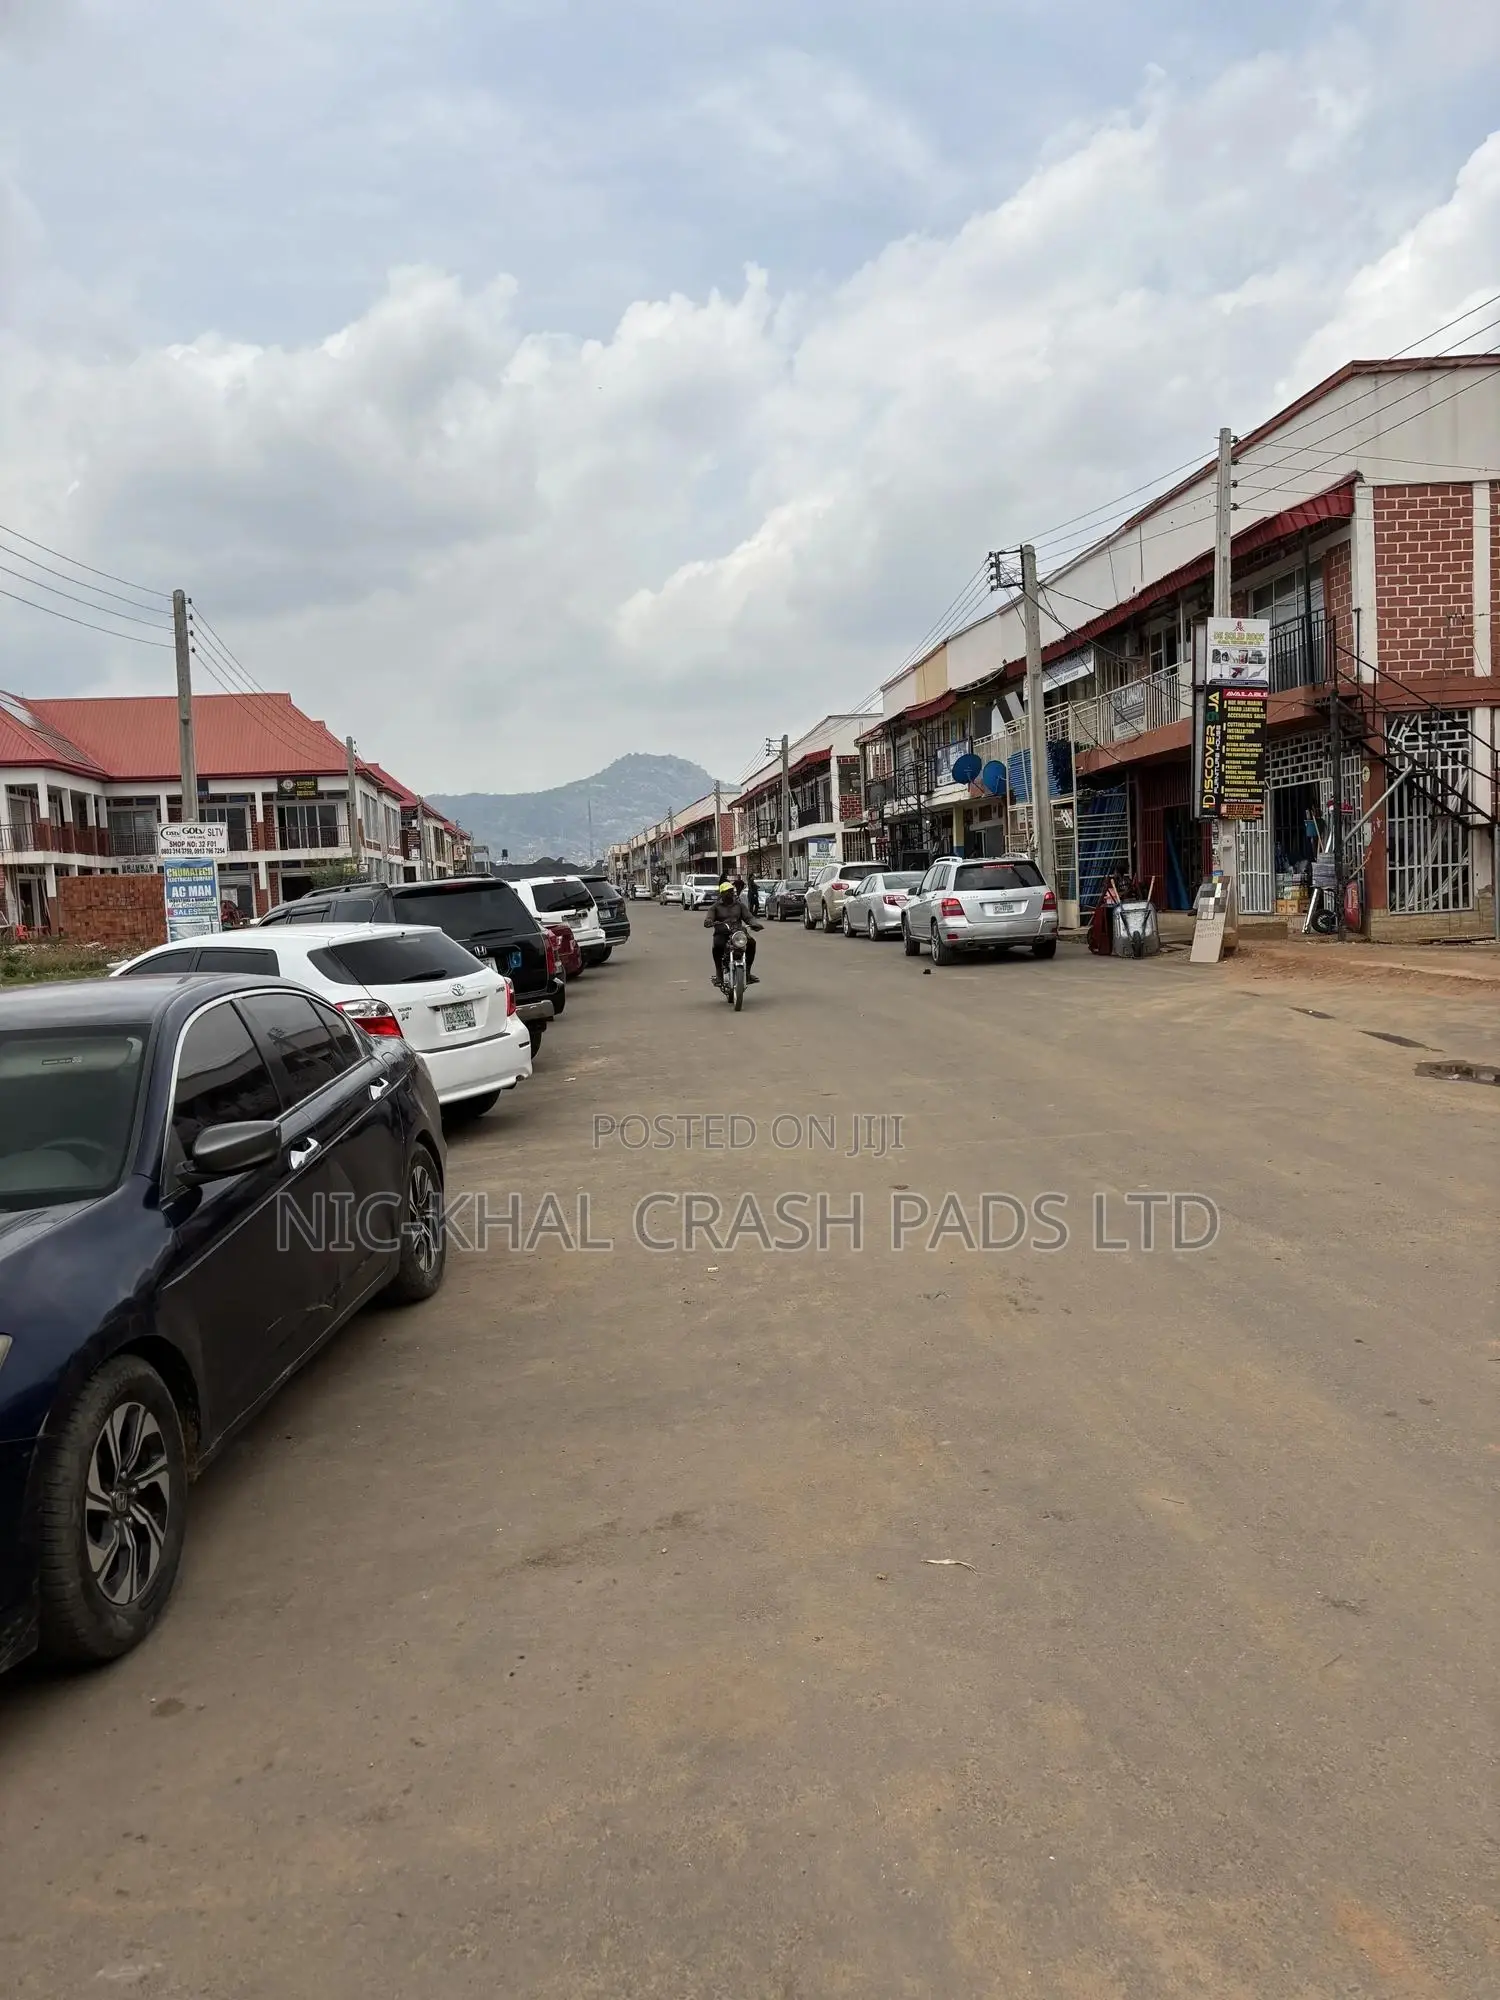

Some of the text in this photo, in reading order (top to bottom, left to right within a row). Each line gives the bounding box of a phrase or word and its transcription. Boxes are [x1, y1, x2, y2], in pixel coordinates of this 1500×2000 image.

[1203, 725, 1216, 808] DISCOVER
[182, 827, 205, 835] GOtv
[207, 828, 224, 837] SLTV
[169, 840, 186, 848] SHOP
[171, 884, 212, 898] AC MAN
[173, 908, 198, 916] SALES
